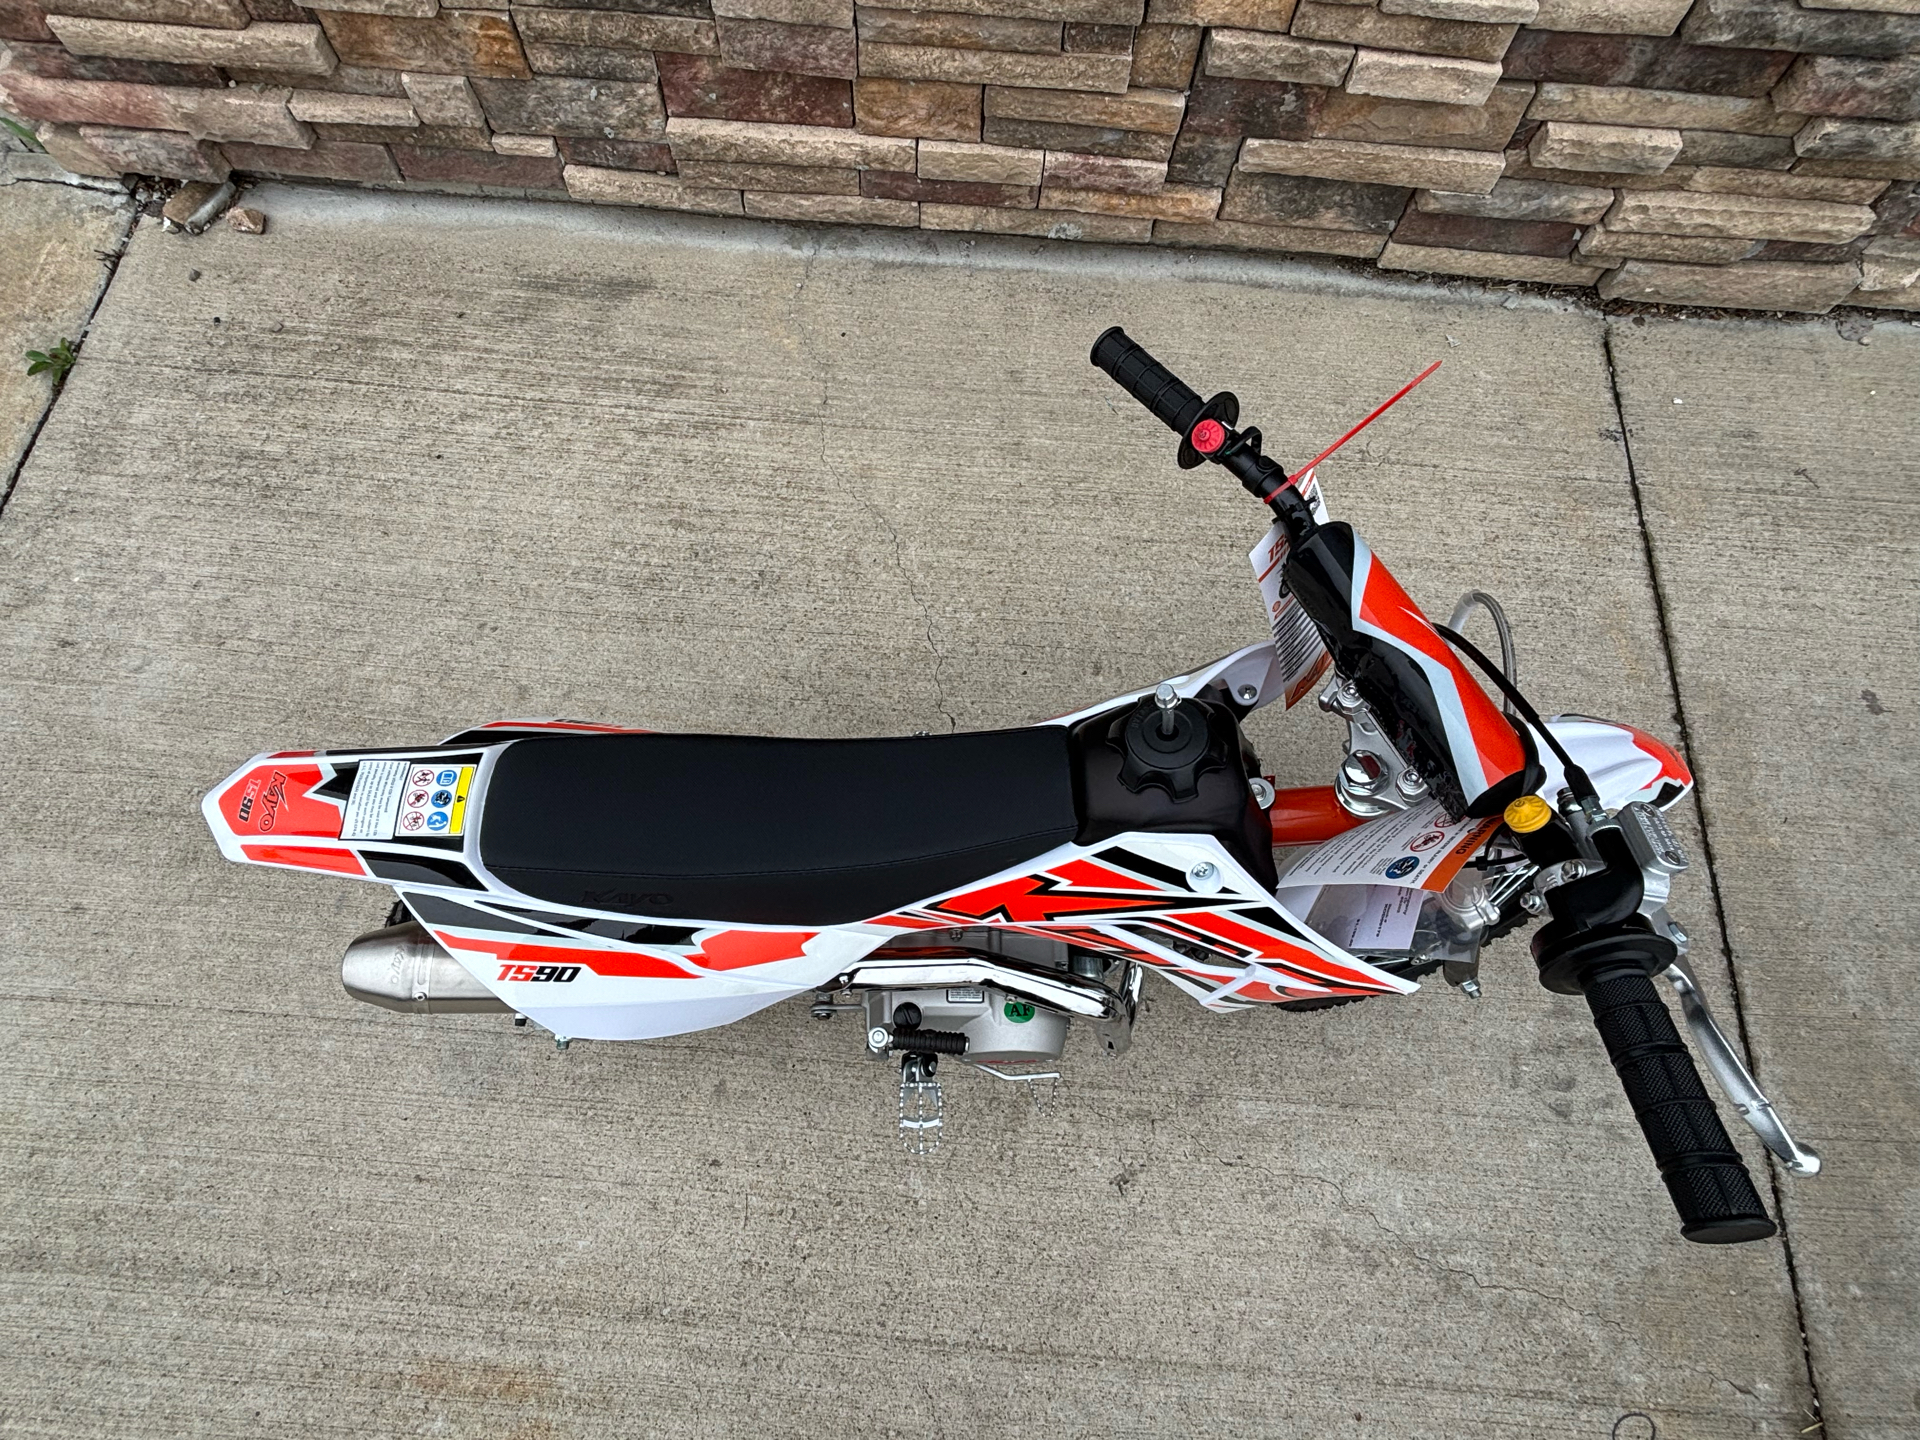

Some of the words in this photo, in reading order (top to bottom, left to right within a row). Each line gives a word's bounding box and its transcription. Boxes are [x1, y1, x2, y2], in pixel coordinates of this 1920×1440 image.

[239, 779, 261, 822] TS90
[259, 770, 288, 832] KAYO
[1455, 817, 1496, 854] WARNING
[497, 964, 582, 982] TS90
[1009, 1003, 1032, 1017] AF
